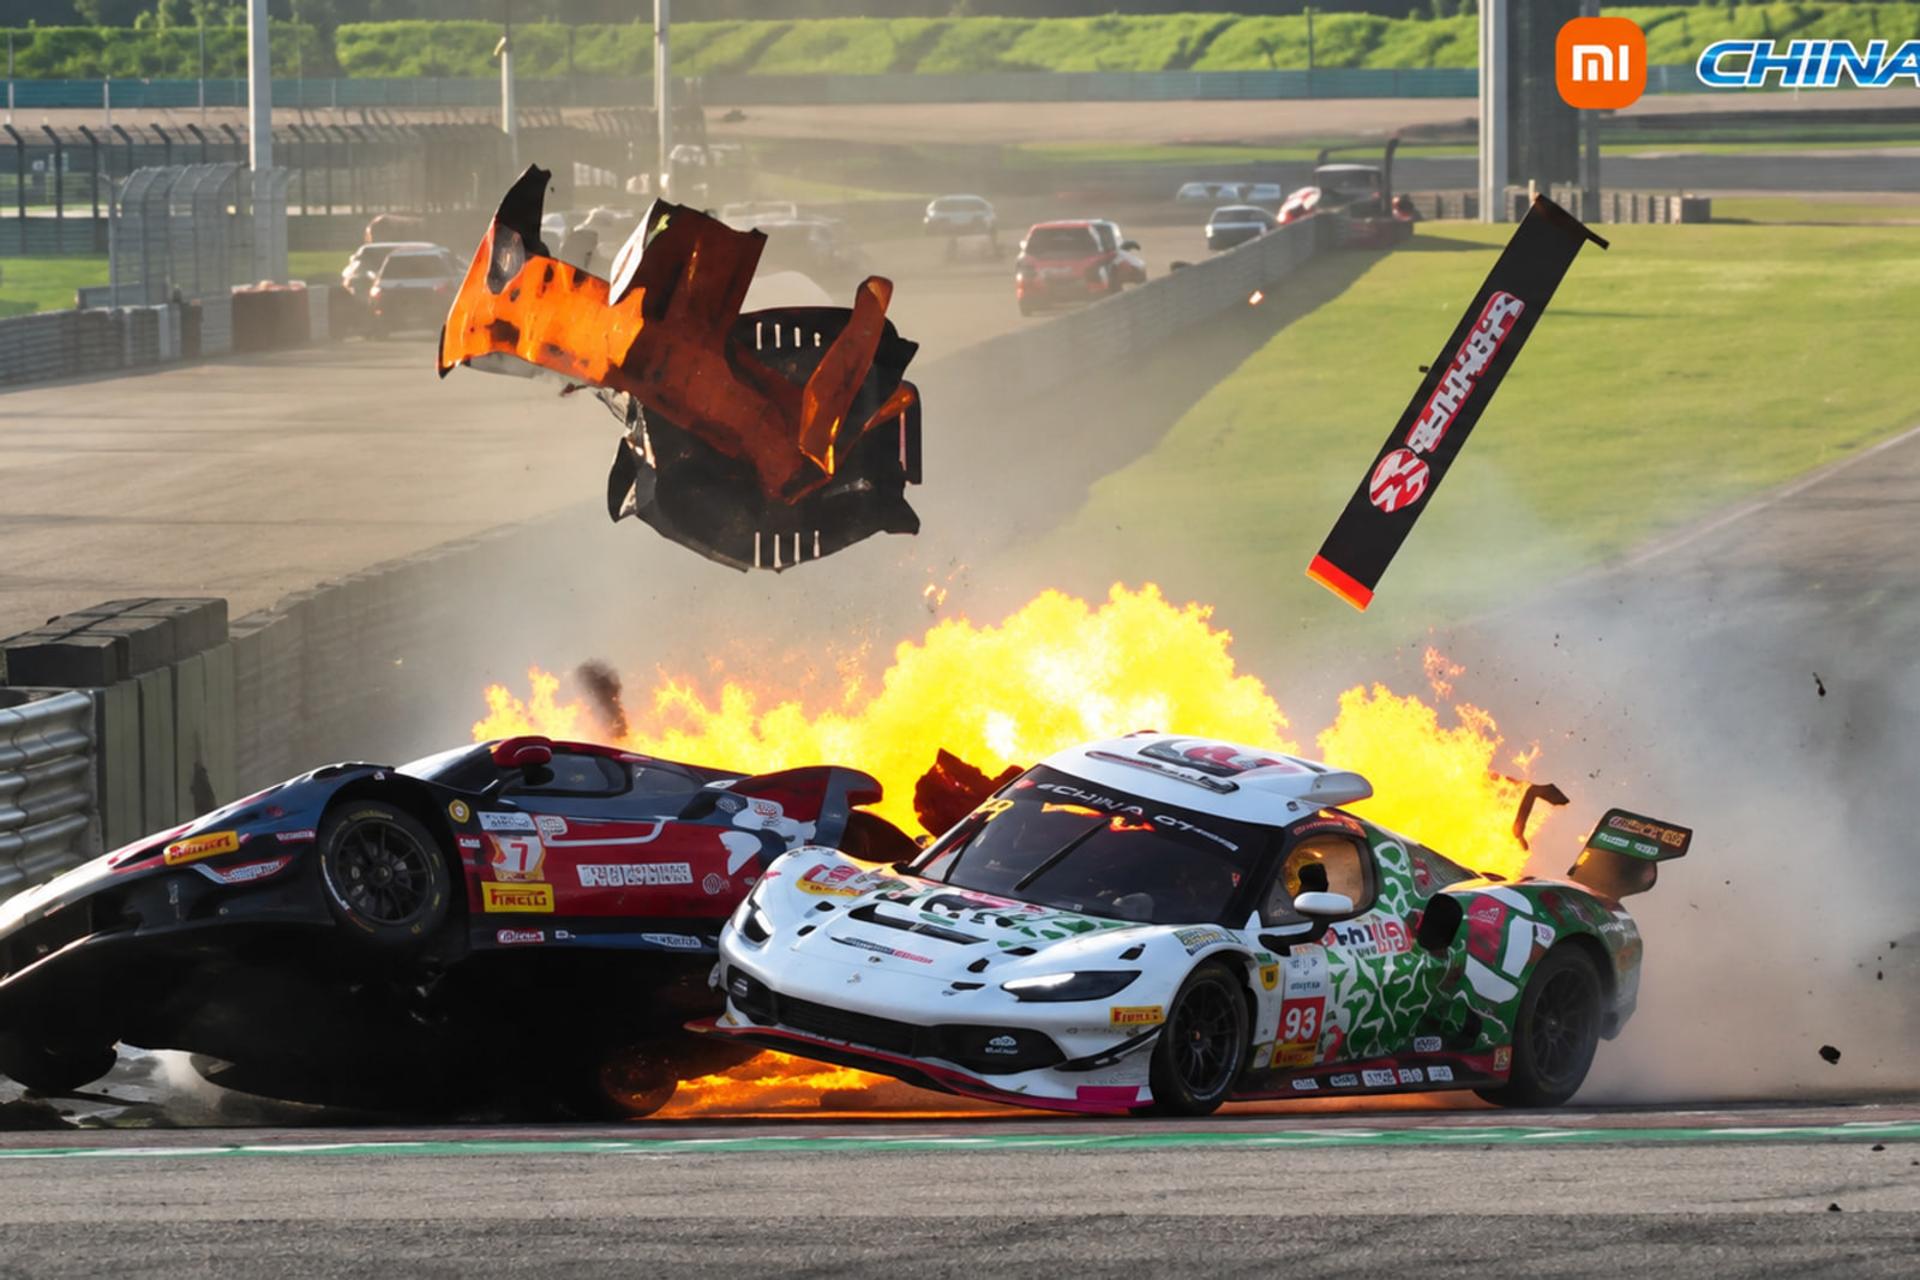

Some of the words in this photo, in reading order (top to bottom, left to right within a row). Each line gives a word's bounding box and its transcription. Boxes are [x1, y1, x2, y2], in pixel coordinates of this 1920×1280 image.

[510, 842, 528, 873] 7
[489, 888, 548, 906] PIRELLI
[1284, 1007, 1317, 1041] 93
